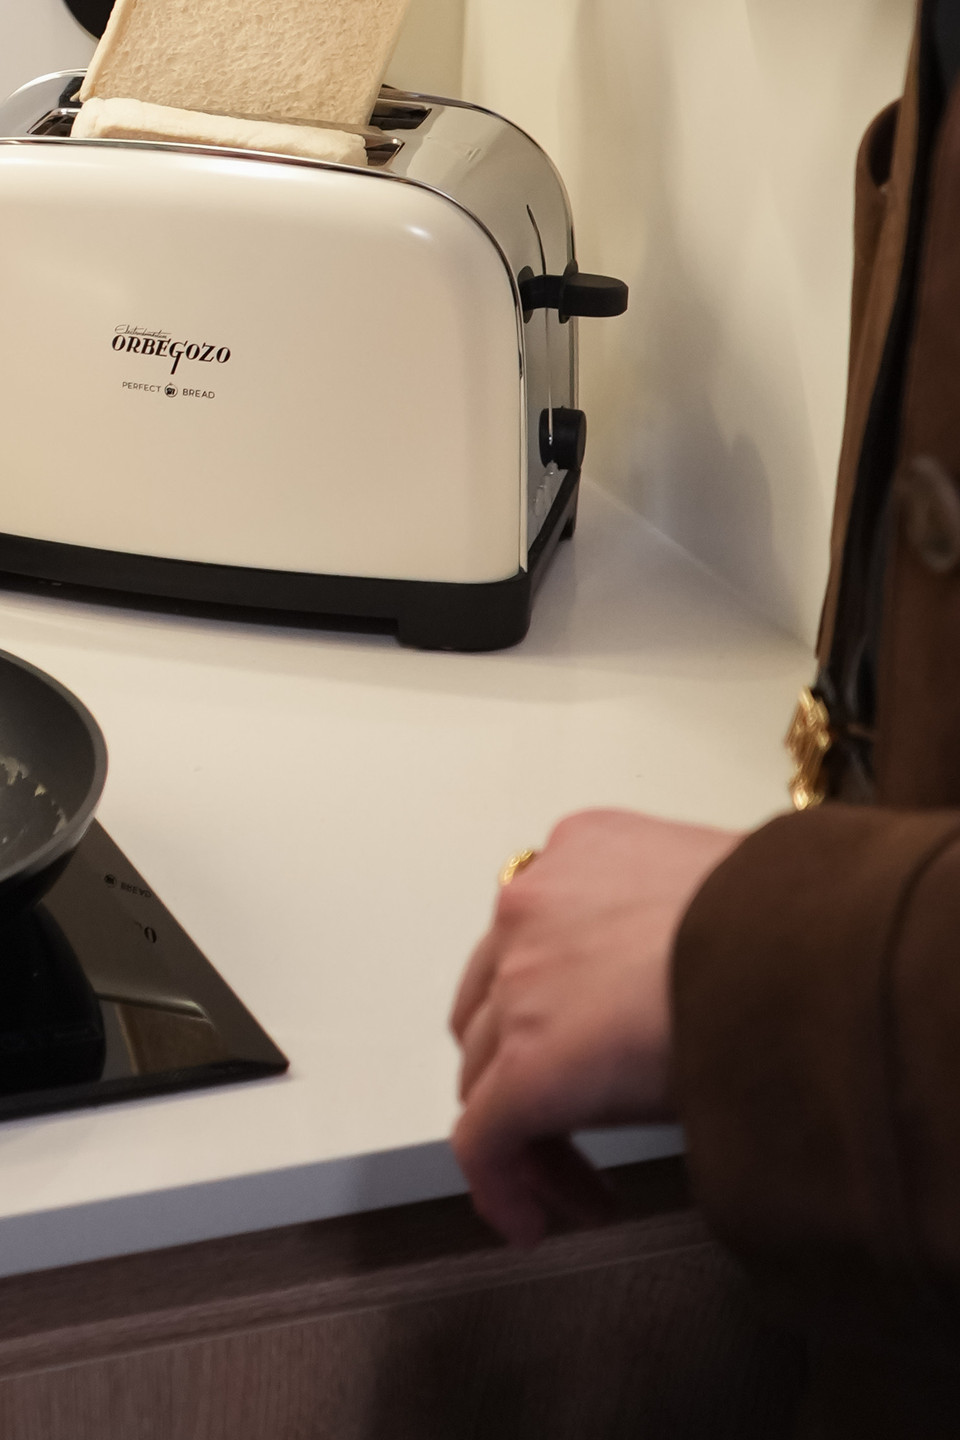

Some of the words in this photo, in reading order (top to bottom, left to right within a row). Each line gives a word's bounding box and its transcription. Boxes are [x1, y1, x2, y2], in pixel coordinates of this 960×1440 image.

[111, 334, 231, 375] ORBEGOZO
[122, 381, 161, 393] PERFECT
[182, 388, 216, 399] BREAD
